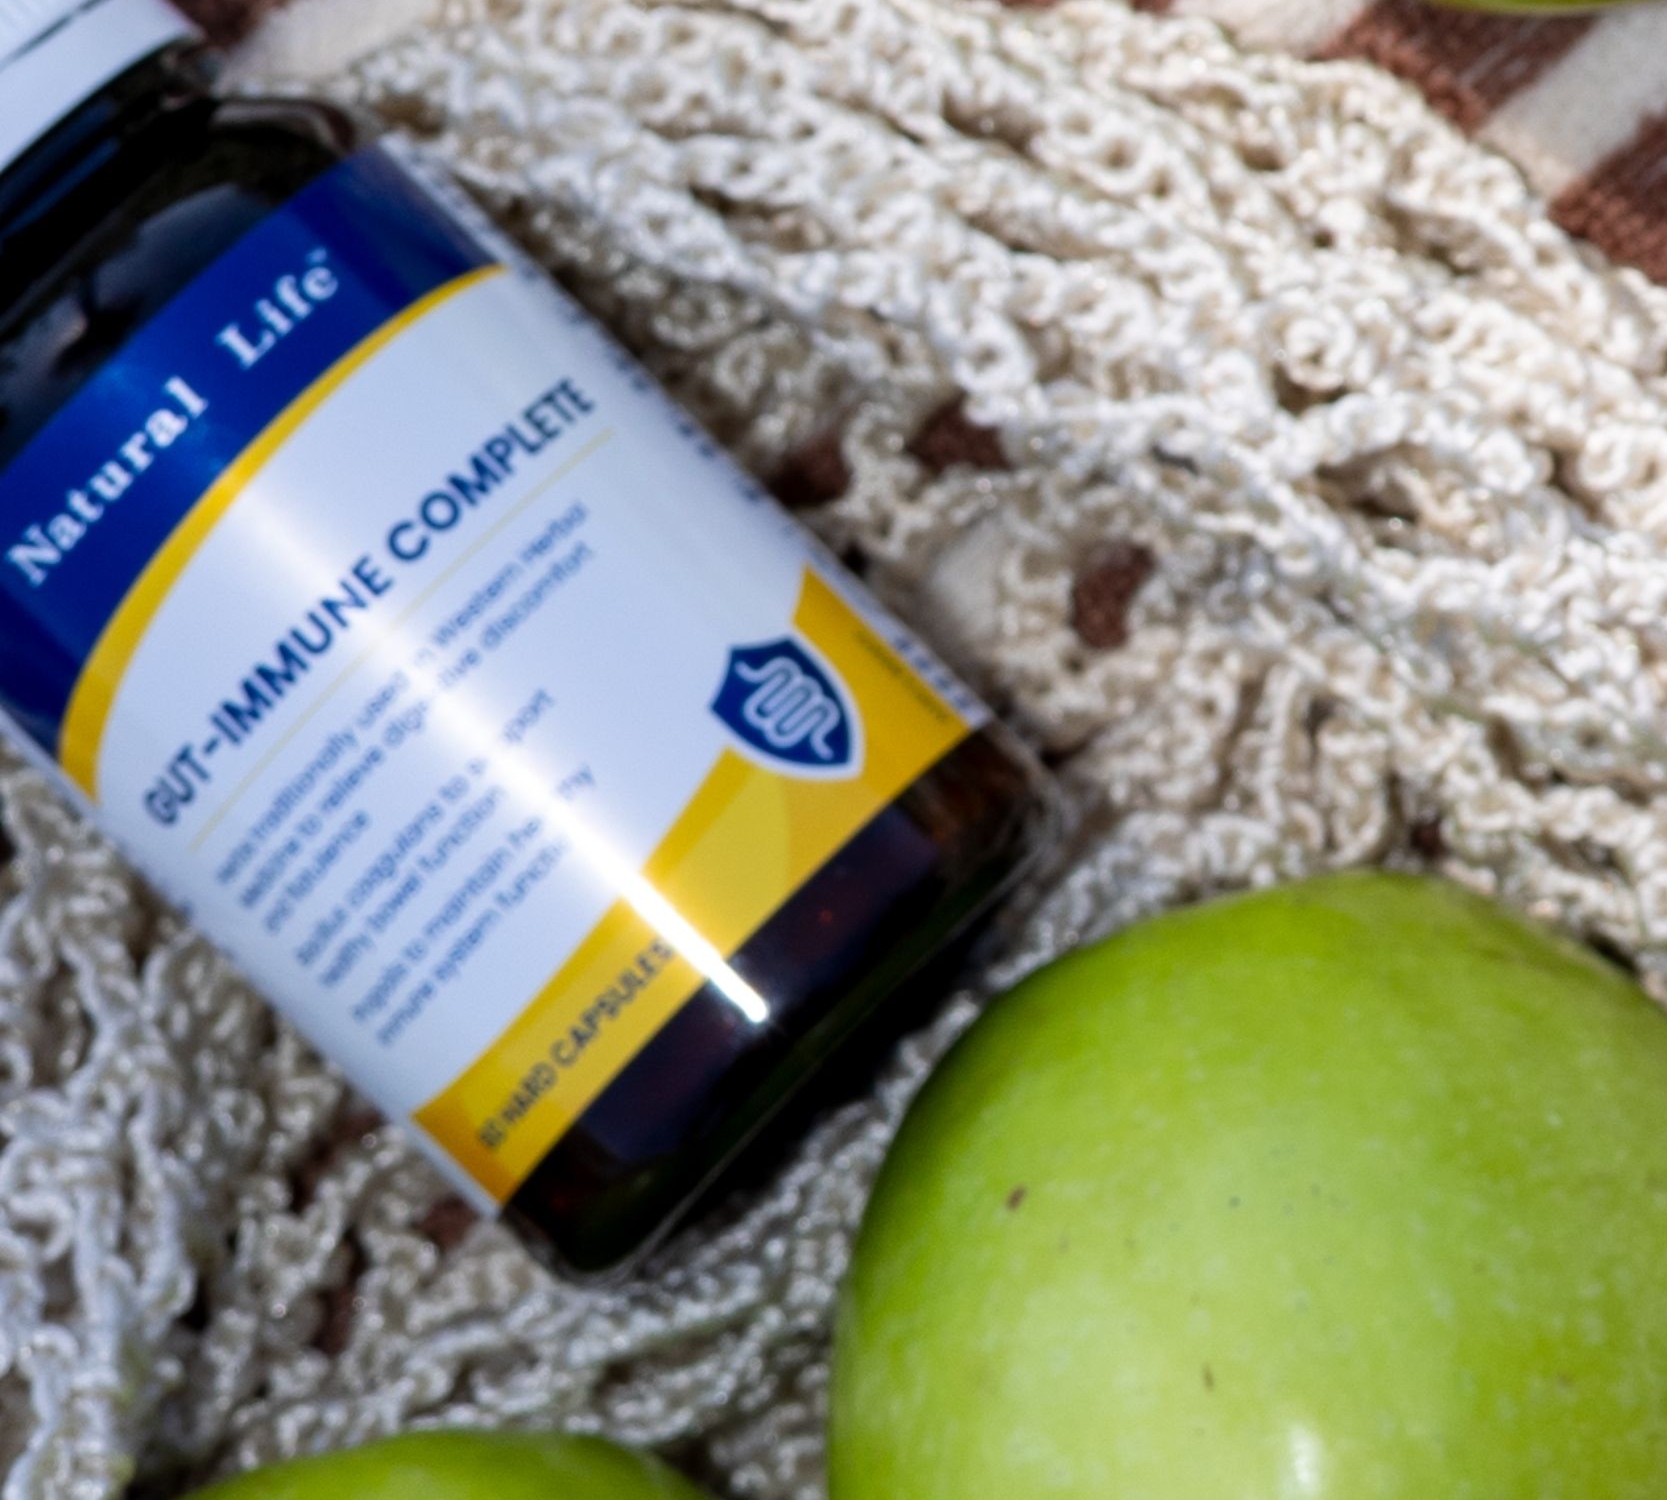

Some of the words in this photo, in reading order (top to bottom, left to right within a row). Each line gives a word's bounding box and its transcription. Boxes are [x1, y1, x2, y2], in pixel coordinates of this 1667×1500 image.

[8, 375, 208, 583] Natural
[143, 553, 395, 826] GUT-IMMUNE
[384, 377, 593, 564] COMPLETE
